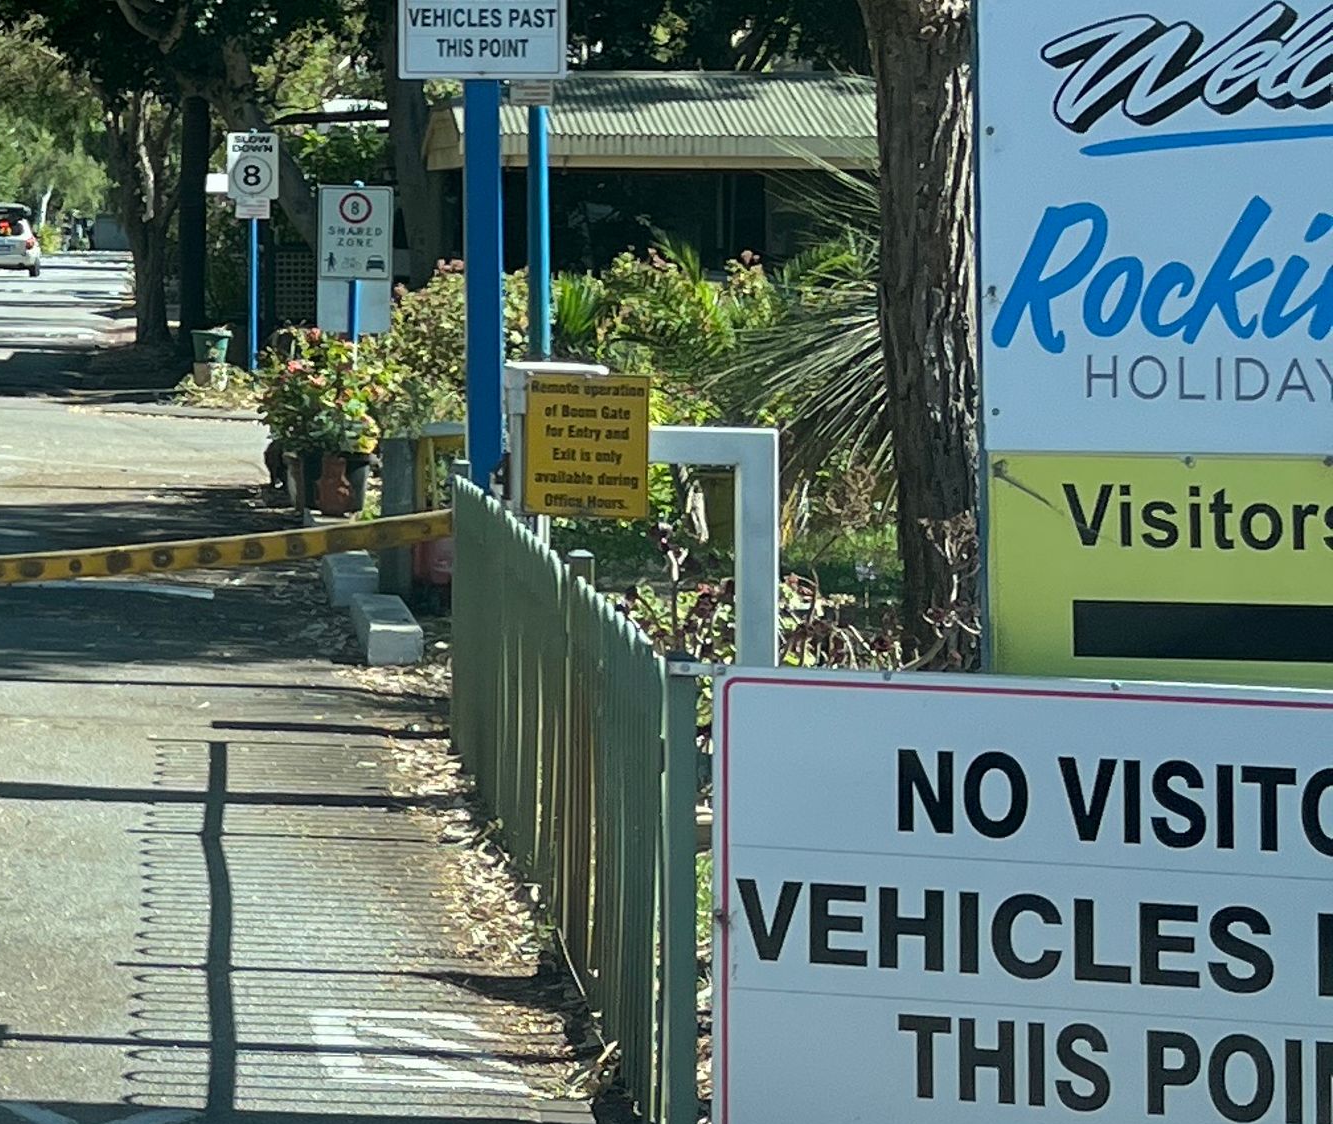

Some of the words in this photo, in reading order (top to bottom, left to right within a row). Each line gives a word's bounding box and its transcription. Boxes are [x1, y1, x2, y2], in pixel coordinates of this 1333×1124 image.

[408, 8, 502, 28] VEHICLES
[509, 8, 557, 28] PAST
[436, 38, 474, 58] THIS
[479, 38, 529, 58] POINT
[232, 144, 273, 153] DOWN
[234, 135, 271, 144] SLOW
[243, 164, 261, 187] 8
[351, 201, 360, 216] 8
[327, 225, 384, 236] SHARED
[336, 238, 374, 248] ZONE
[531, 380, 580, 395] Remote
[583, 384, 645, 398] operation
[544, 404, 558, 417] of
[561, 404, 597, 418] Boom
[601, 405, 631, 420] Gate
[545, 424, 564, 438] for
[568, 425, 601, 441] Entry
[605, 427, 630, 440] and
[553, 447, 576, 461] Exit
[580, 448, 591, 461] is
[595, 450, 623, 465] only
[534, 471, 593, 484] available
[598, 472, 639, 489] during
[544, 493, 583, 508] Office
[1062, 482, 1333, 551] Visitor
[897, 748, 1029, 840] NO
[735, 878, 1275, 995] VEHICLES
[897, 1013, 1111, 1113] THIS
